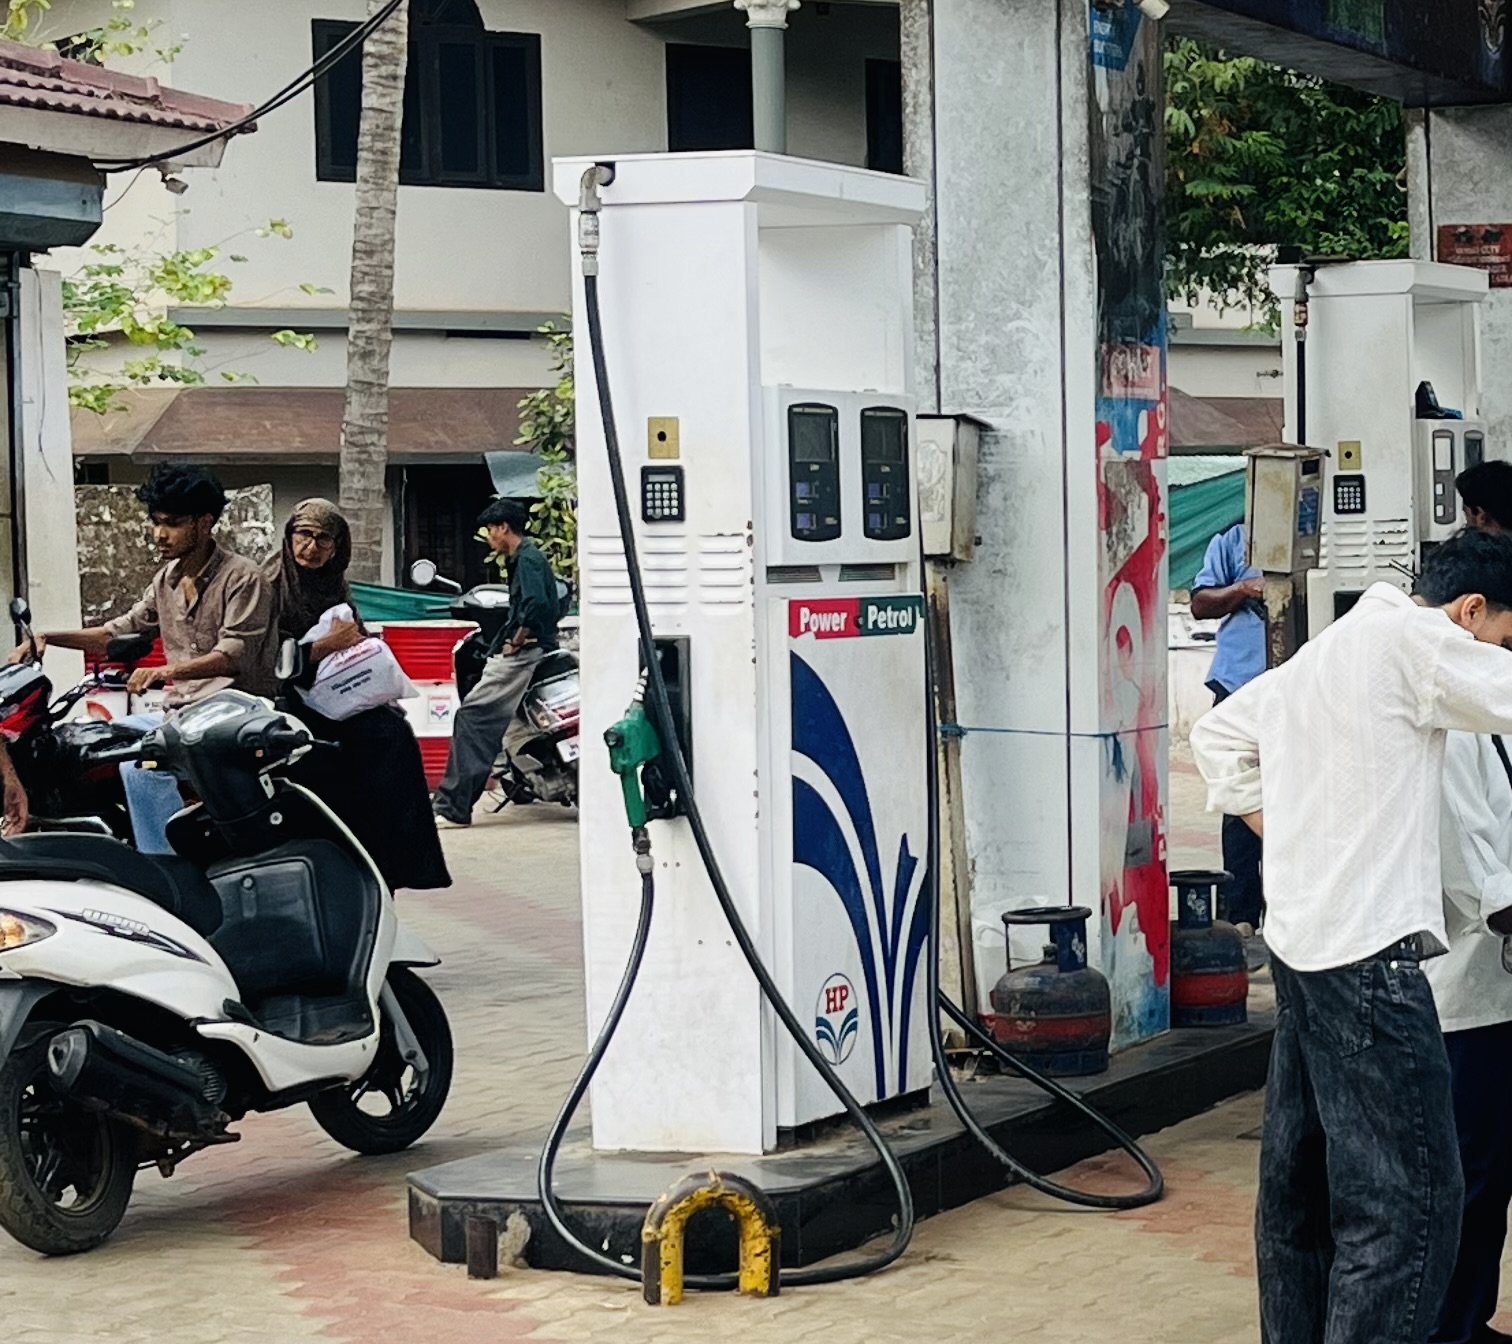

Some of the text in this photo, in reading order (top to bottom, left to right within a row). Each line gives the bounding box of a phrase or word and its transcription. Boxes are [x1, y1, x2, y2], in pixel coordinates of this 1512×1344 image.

[800, 605, 913, 633] Power Petrol
[825, 984, 849, 1014] HP
